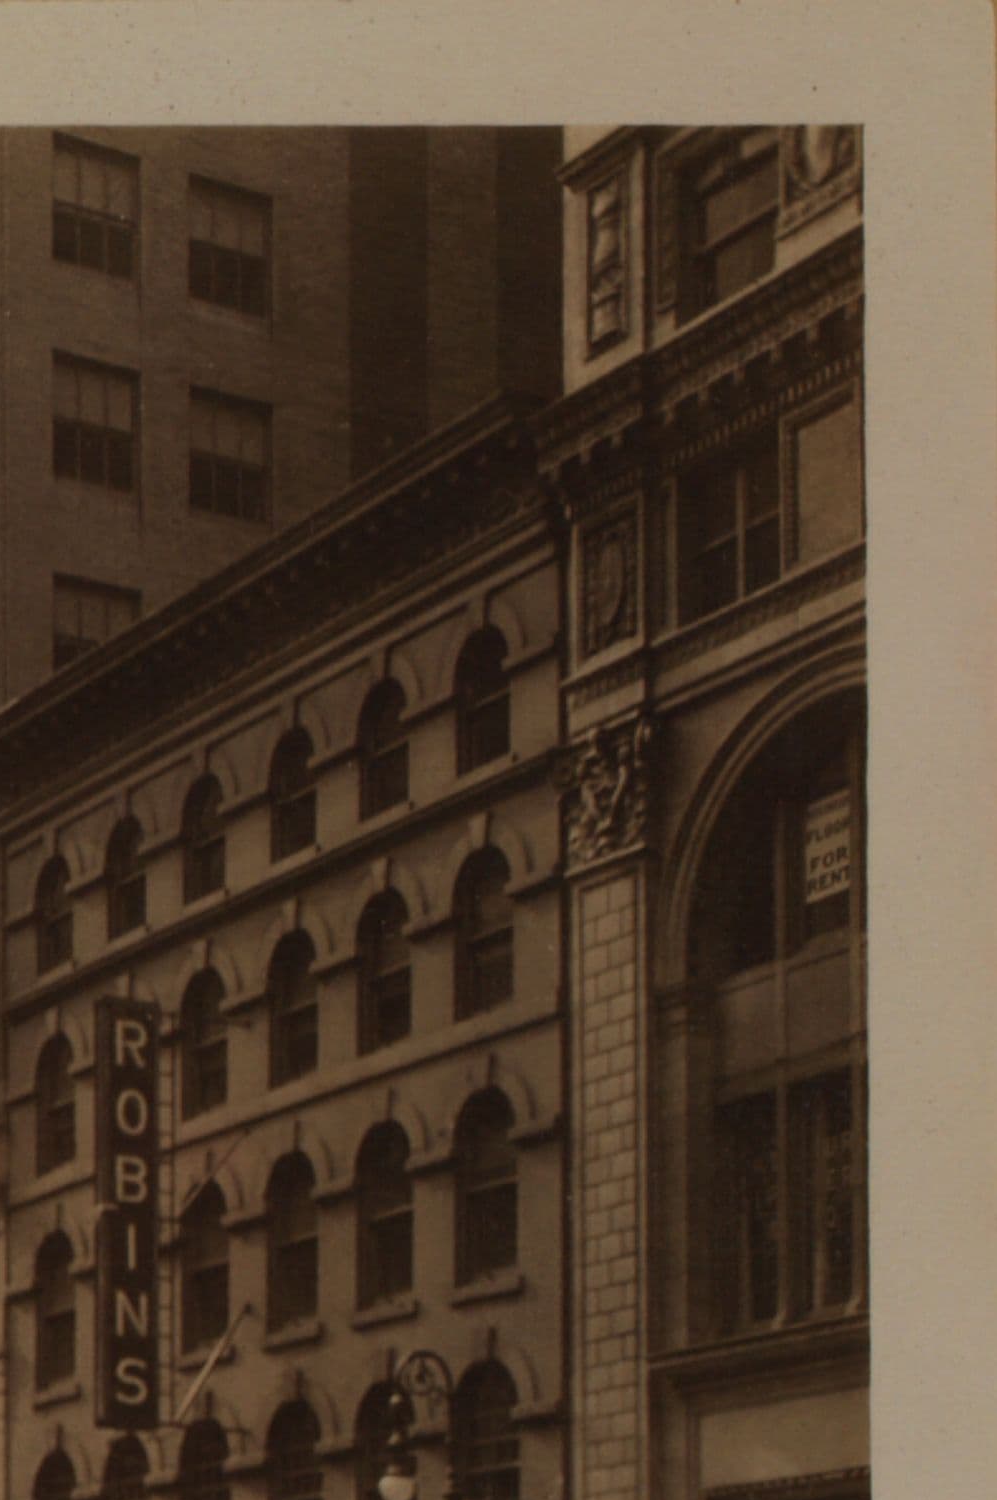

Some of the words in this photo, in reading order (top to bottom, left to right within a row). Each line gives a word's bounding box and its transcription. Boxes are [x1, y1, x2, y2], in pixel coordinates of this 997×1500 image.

[809, 846, 848, 871] FOR
[807, 865, 851, 895] RENT
[113, 1018, 148, 1406] ROBINS
